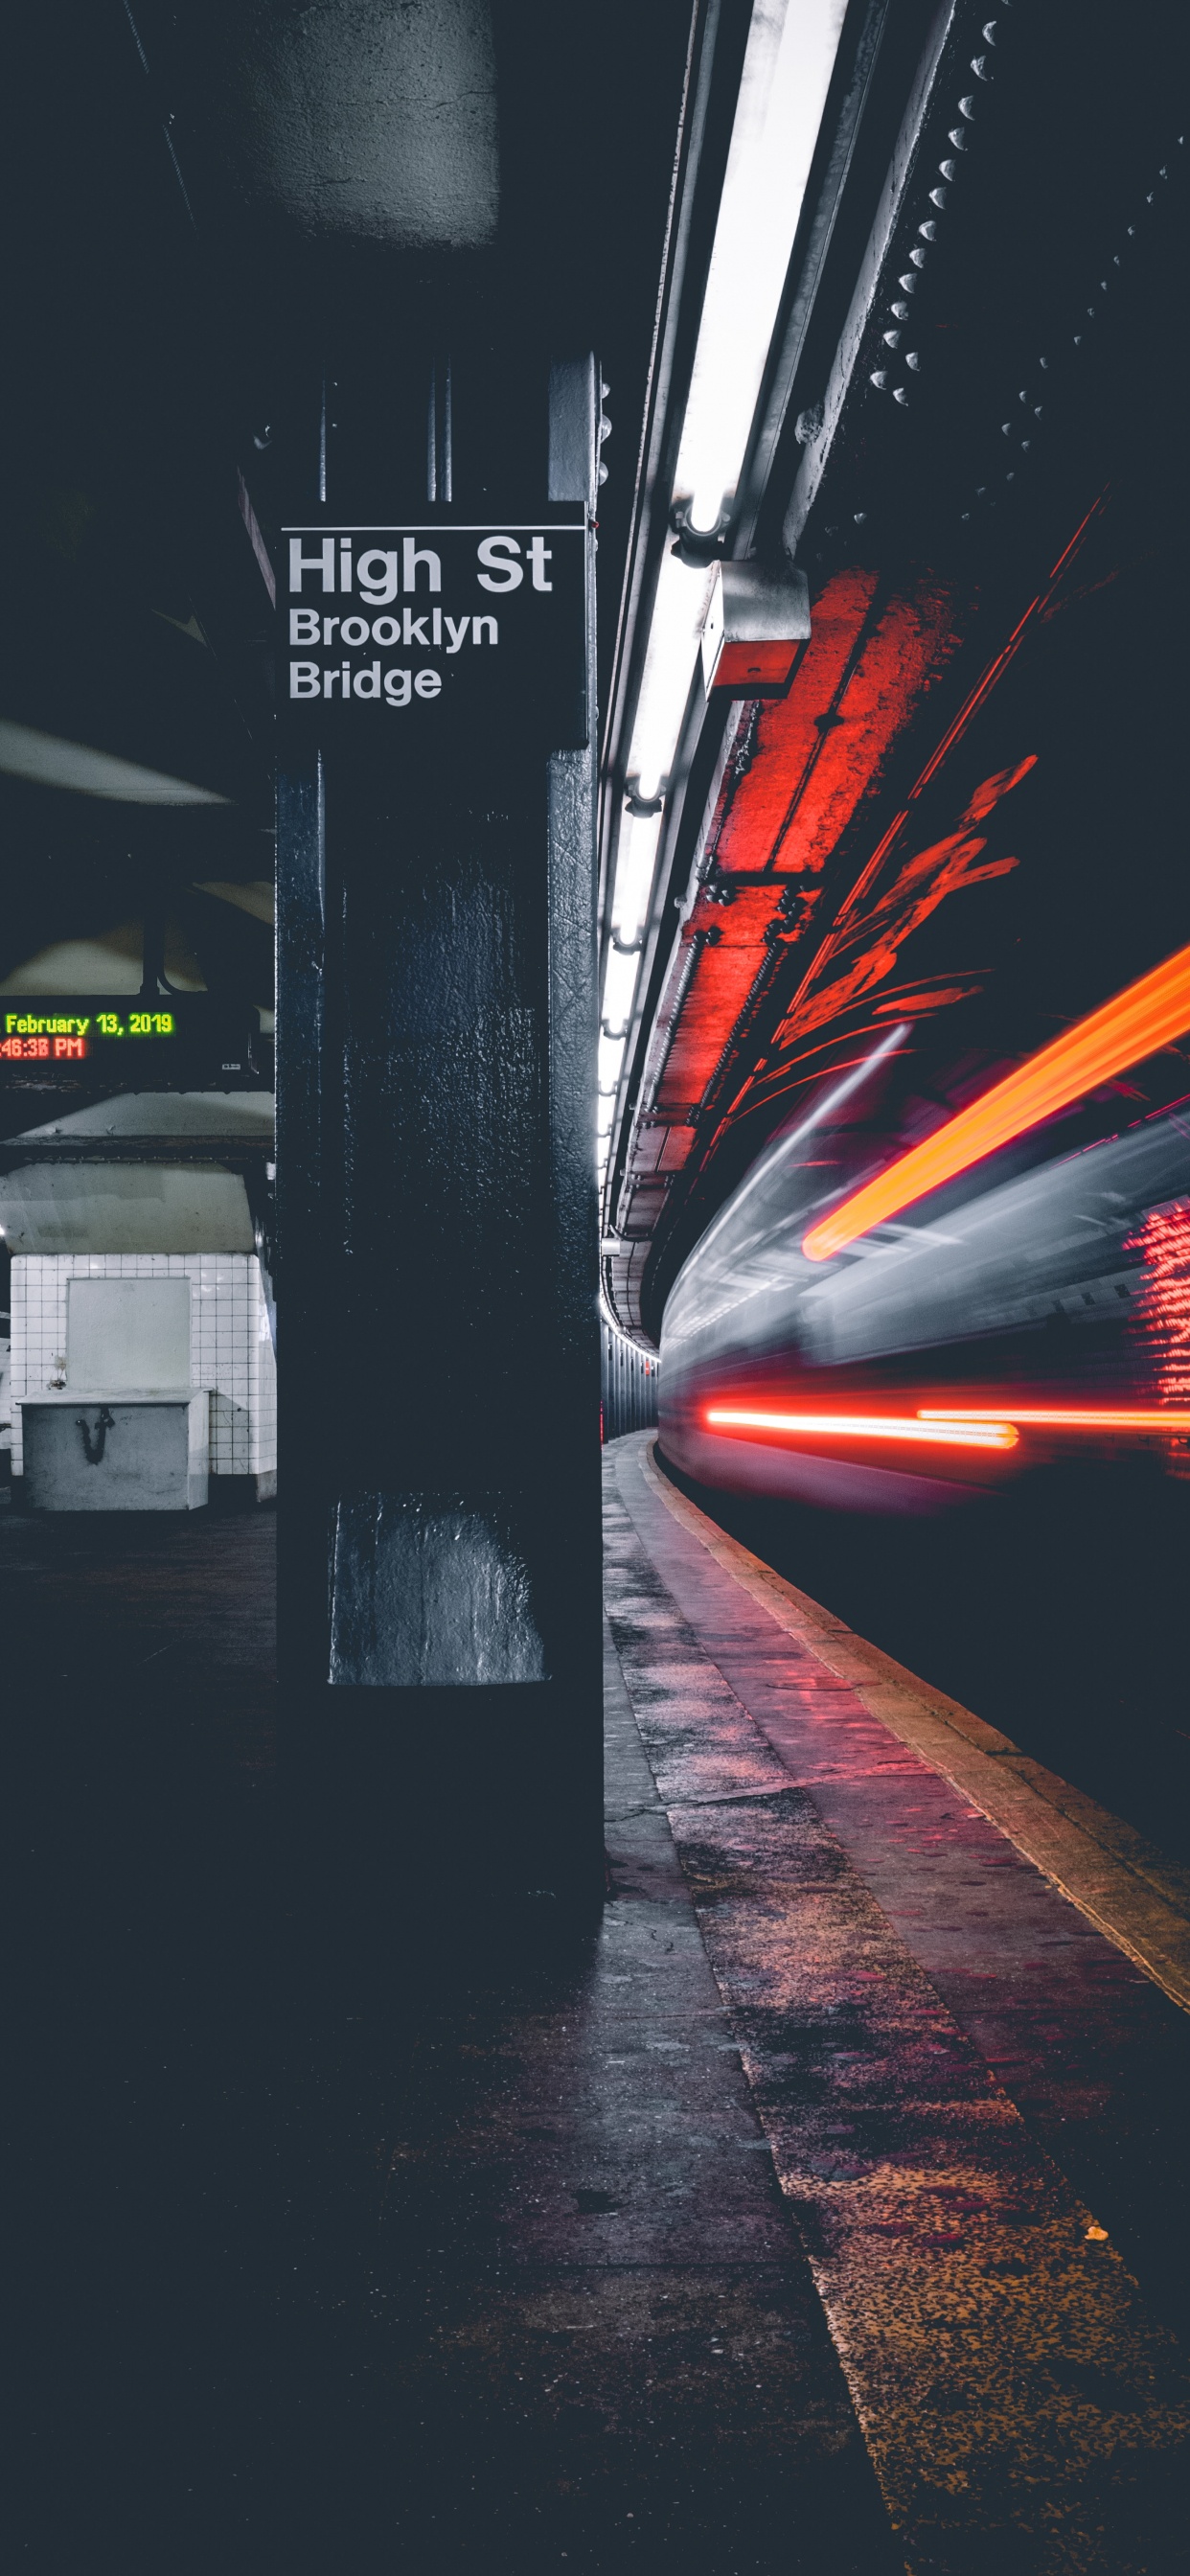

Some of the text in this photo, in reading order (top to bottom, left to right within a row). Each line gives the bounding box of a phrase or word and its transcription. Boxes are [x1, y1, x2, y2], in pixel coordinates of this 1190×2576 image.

[289, 536, 552, 605] High St
[289, 608, 498, 654] Brooklyn
[289, 660, 442, 706] Bridge
[6, 1014, 172, 1036] February 13, 2019
[55, 1038, 83, 1057] PM
